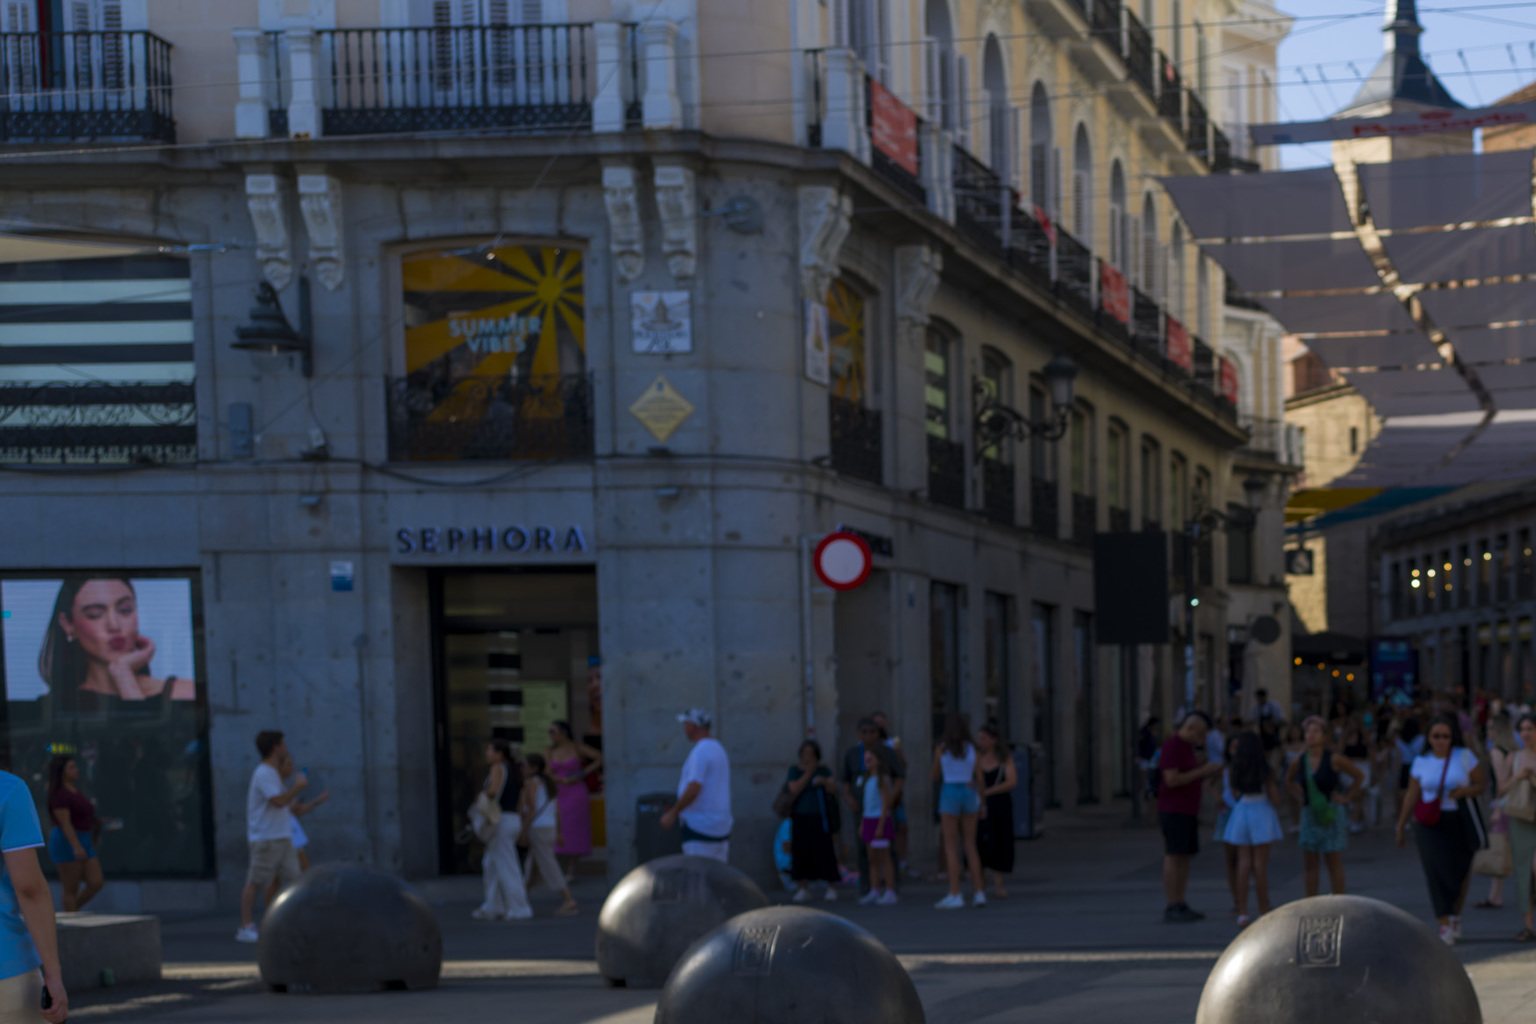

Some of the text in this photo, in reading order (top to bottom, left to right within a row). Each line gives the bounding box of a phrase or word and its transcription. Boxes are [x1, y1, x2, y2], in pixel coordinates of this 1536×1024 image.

[448, 317, 542, 337] SUMMER
[466, 335, 527, 354] VIBES
[397, 526, 588, 553] SEPHORA
